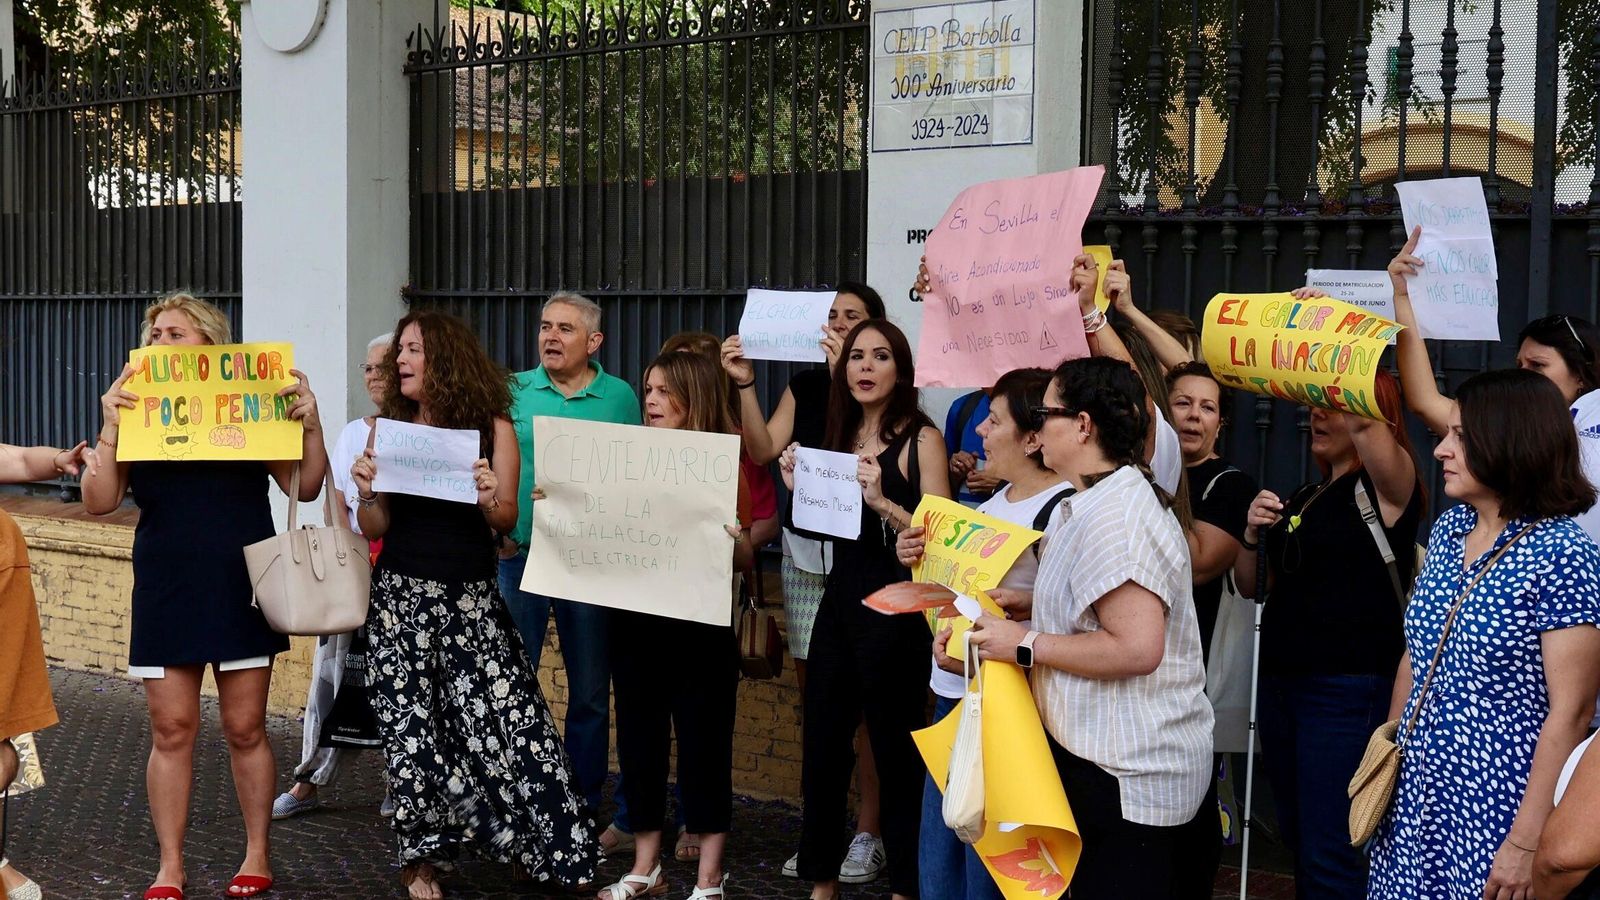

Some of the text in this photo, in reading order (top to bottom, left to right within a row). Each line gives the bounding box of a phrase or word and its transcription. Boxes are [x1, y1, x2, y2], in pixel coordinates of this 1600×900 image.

[884, 14, 1021, 54] CEIP Borbolla
[926, 73, 1016, 97] Aniversario
[912, 114, 990, 141] 1924-2024
[949, 208, 968, 230] En
[1050, 206, 1061, 221] el
[907, 229, 933, 244] PR
[1217, 300, 1402, 340] EL CALOR MATA
[1230, 336, 1257, 367] LA
[129, 352, 285, 383] MUCHO CALOR
[144, 395, 203, 428] POCO
[394, 455, 452, 473] HUEVOS
[543, 434, 732, 485] CENTENARIO
[584, 492, 651, 520] DE LA
[546, 514, 679, 549] INSTALACION
[924, 510, 1011, 559] NUESTRO
